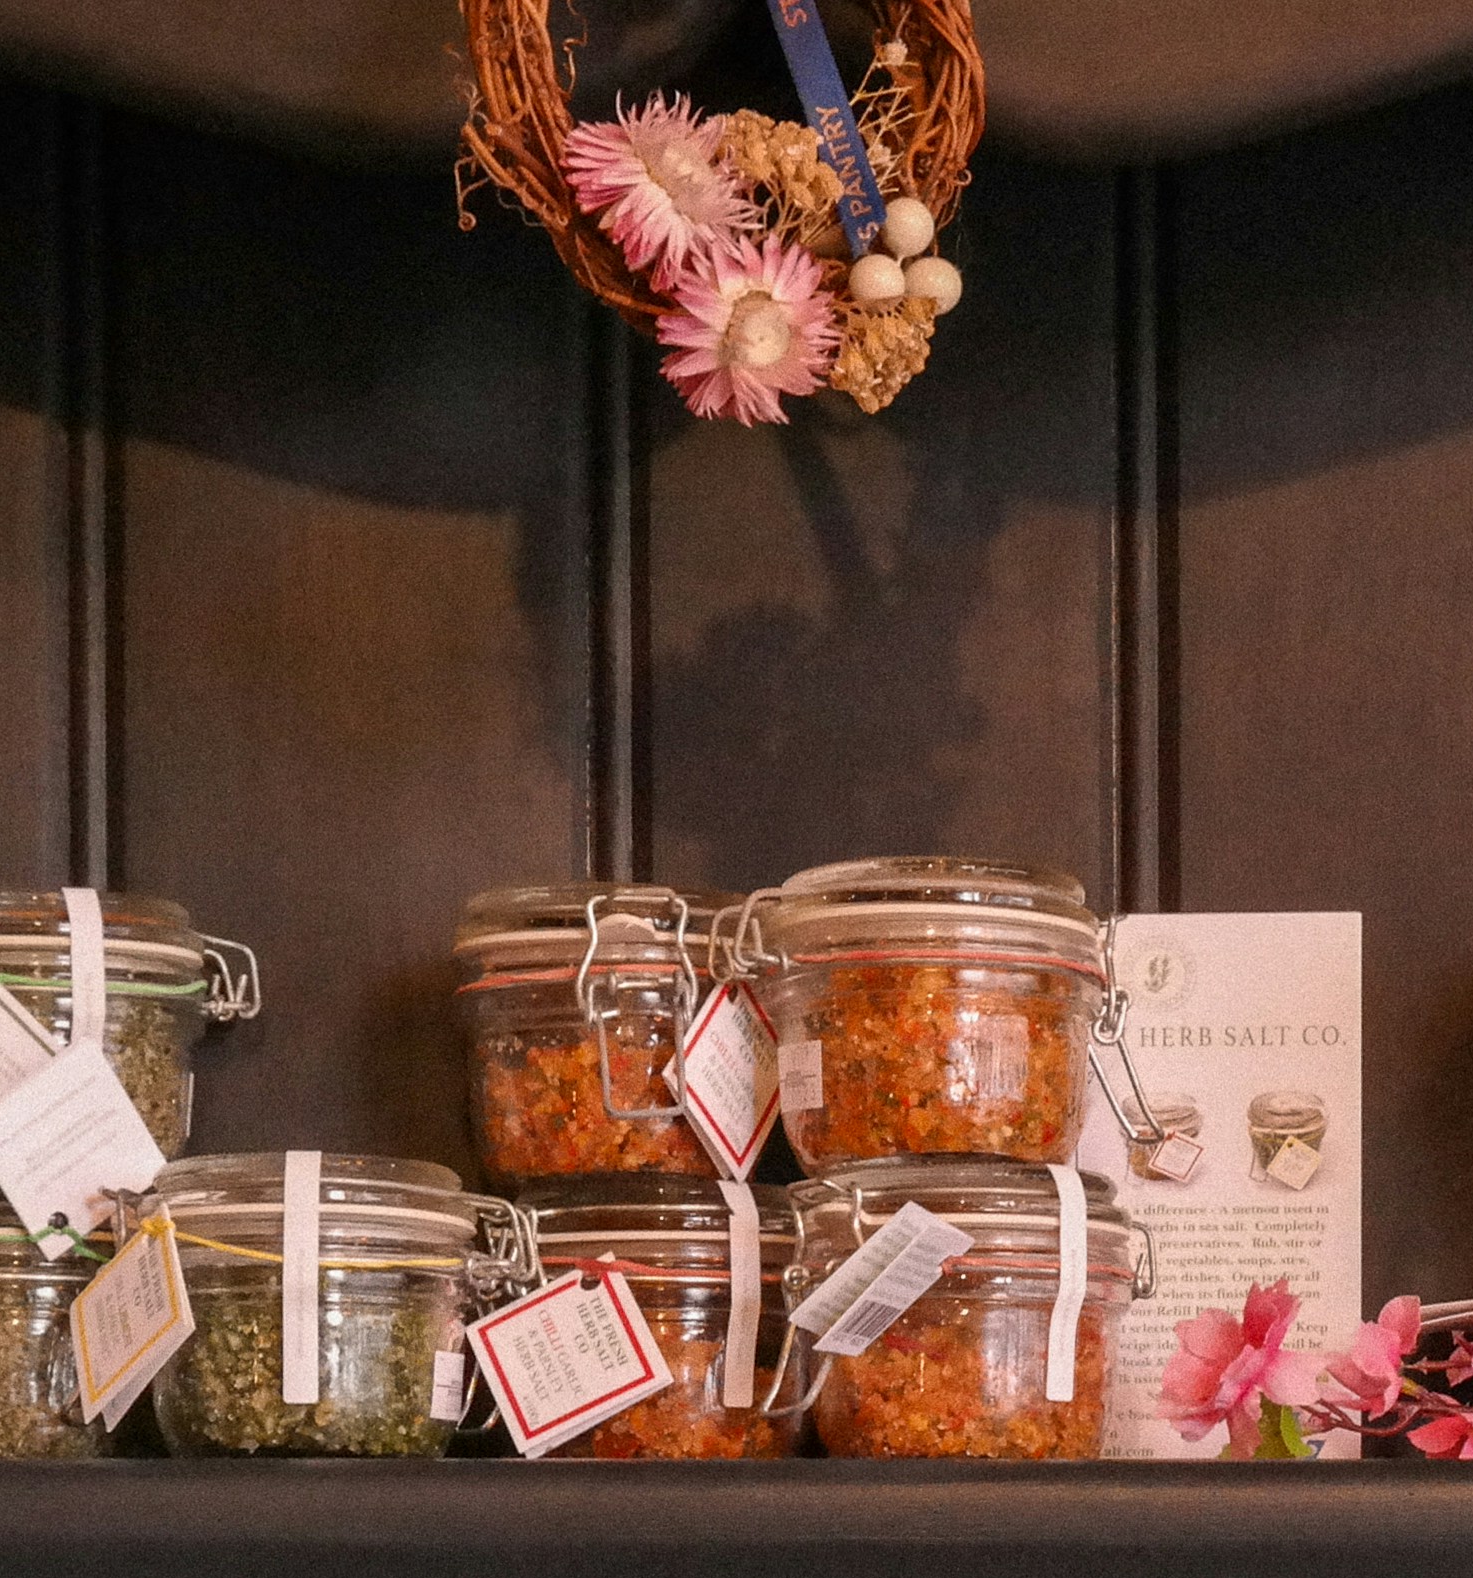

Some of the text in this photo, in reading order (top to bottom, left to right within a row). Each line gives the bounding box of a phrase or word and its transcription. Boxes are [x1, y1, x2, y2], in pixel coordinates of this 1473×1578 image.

[815, 105, 871, 218] PANTRY
[1140, 1025, 1347, 1048] HERB SALT CO.
[1255, 1222, 1325, 1235] Completely
[527, 1327, 563, 1394] & PARSLEY
[537, 1308, 583, 1396] CHILLI GARLIC
[573, 1332, 590, 1354] CO
[576, 1301, 614, 1372] HERB SALT
[589, 1294, 629, 1367] THE FRESH
[513, 1334, 549, 1402] HERB SALT
